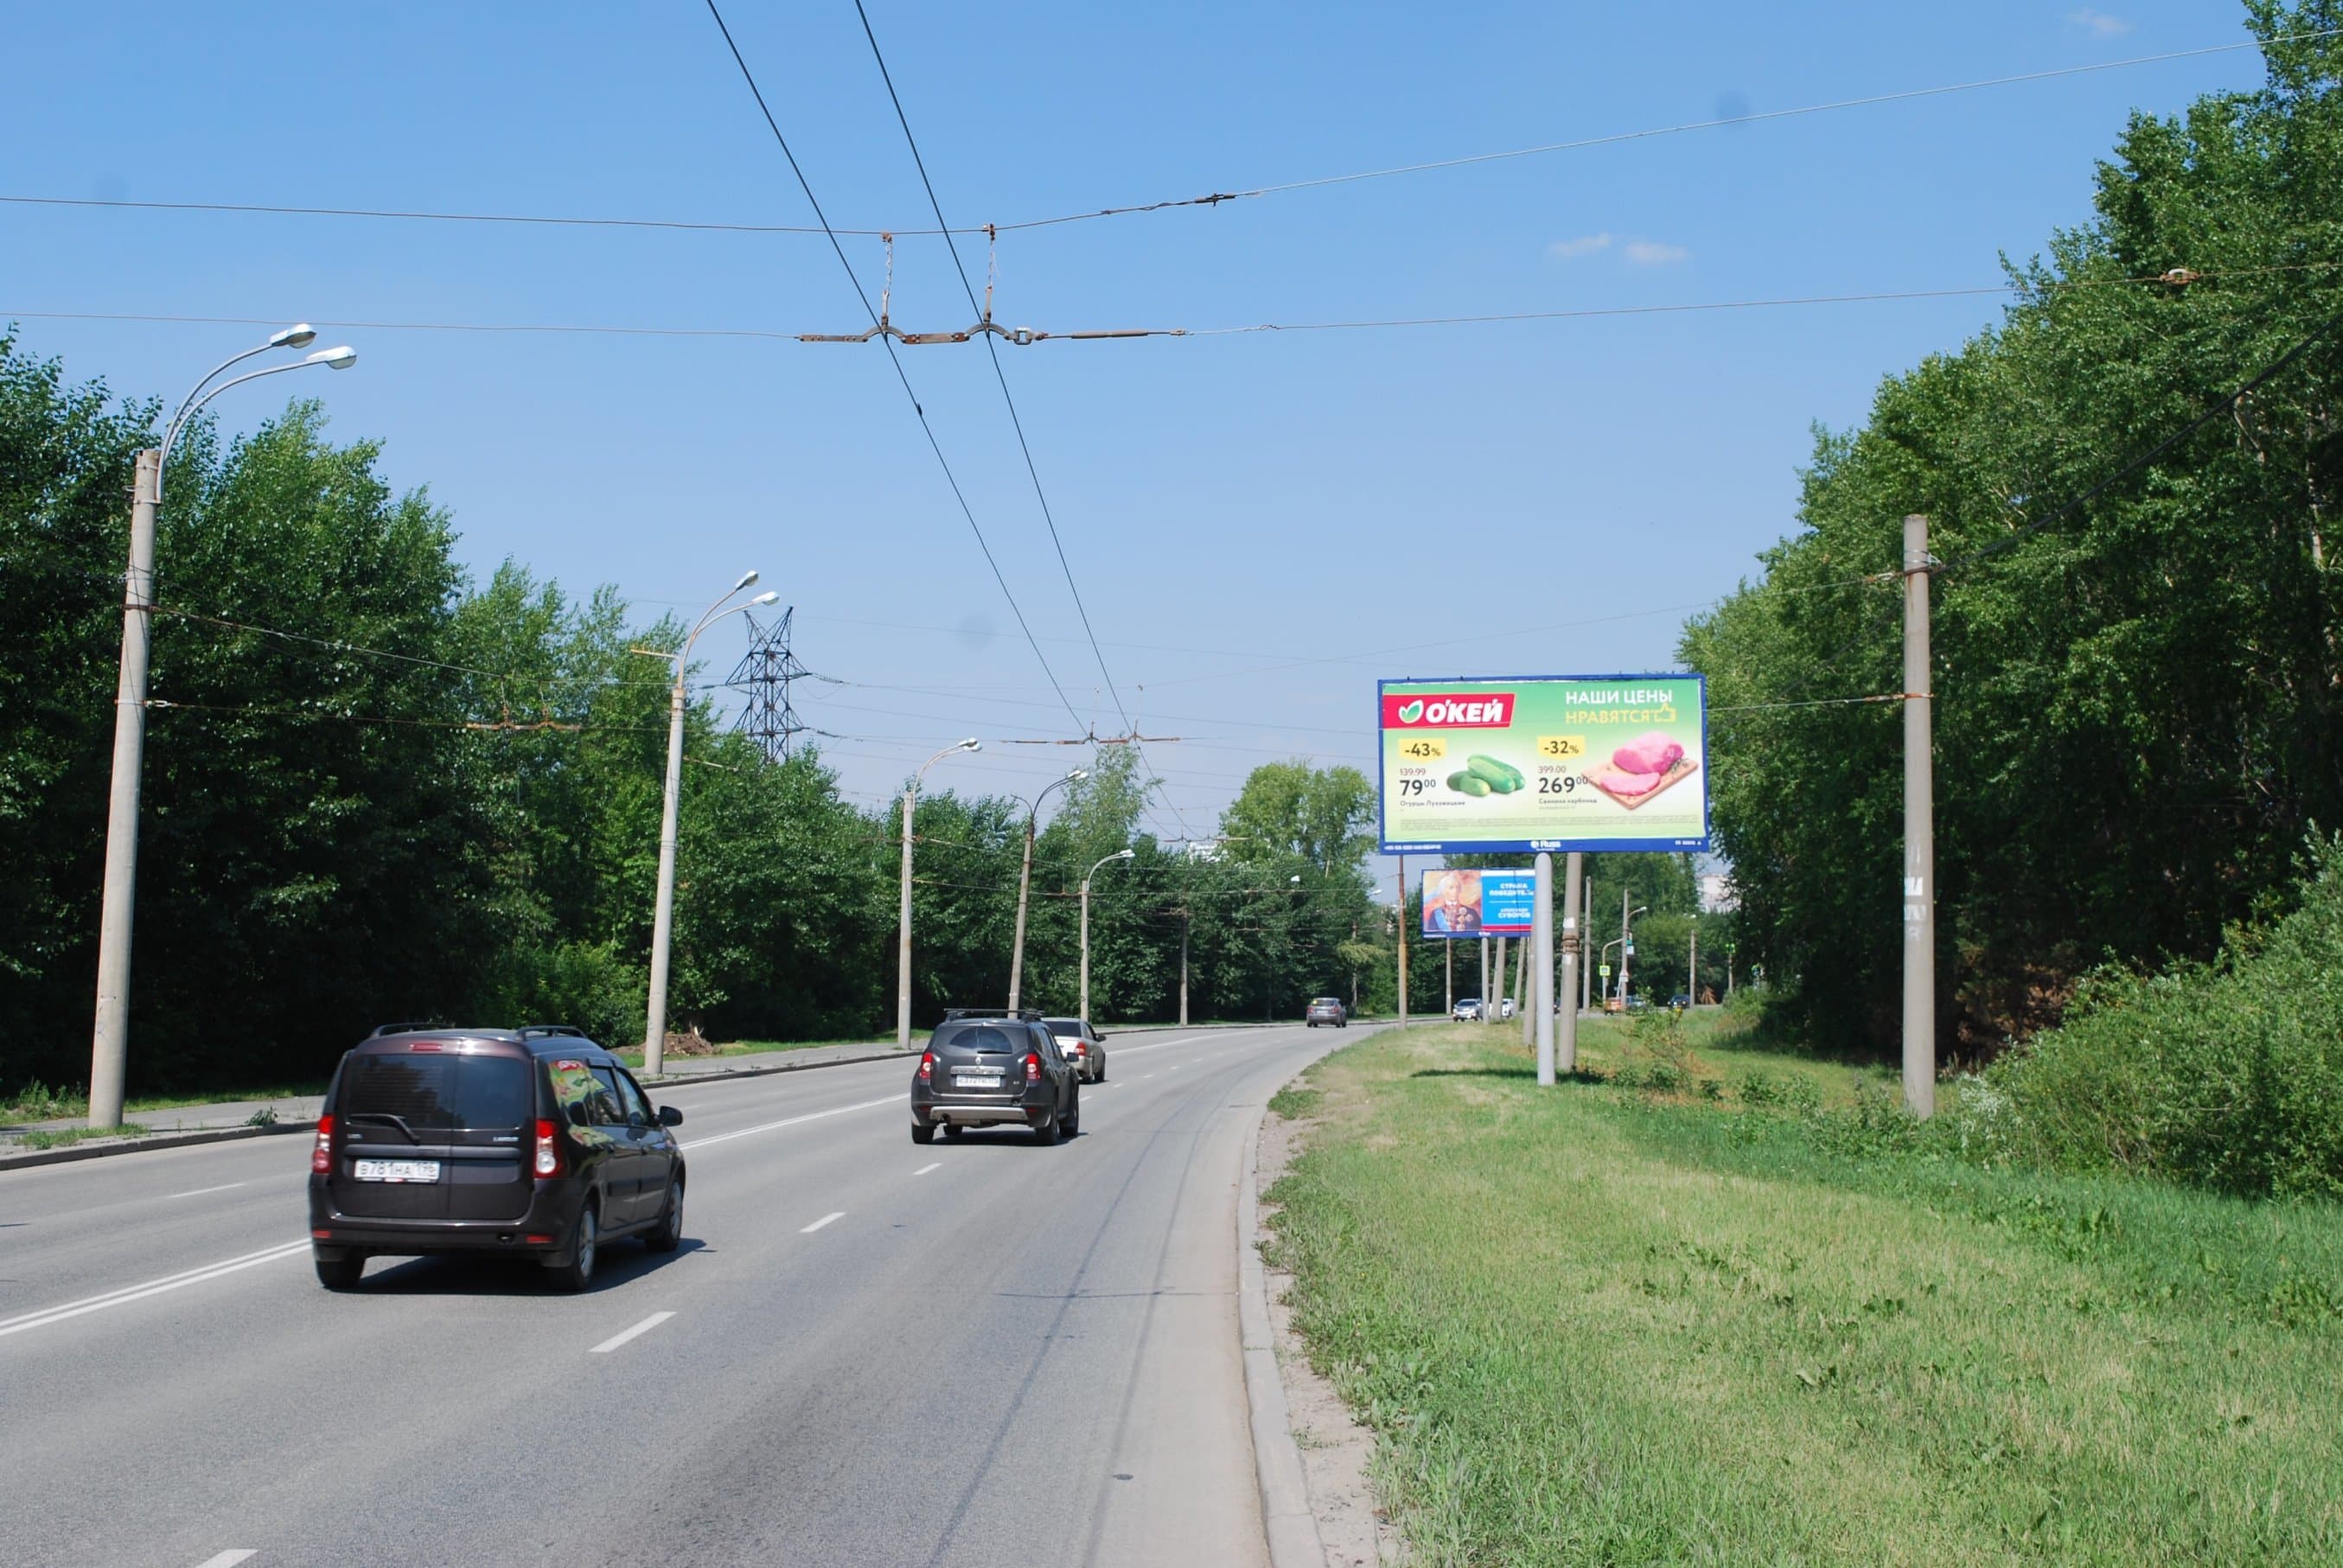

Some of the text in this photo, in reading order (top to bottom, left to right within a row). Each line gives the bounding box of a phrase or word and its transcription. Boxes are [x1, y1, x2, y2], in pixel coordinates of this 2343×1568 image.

[1566, 690, 1673, 706] НАШИ ЦЕНЫ
[1566, 709, 1650, 724] НРАВЯТСЯ
[1405, 743, 1441, 757] -43%
[1544, 741, 1580, 755] -32%
